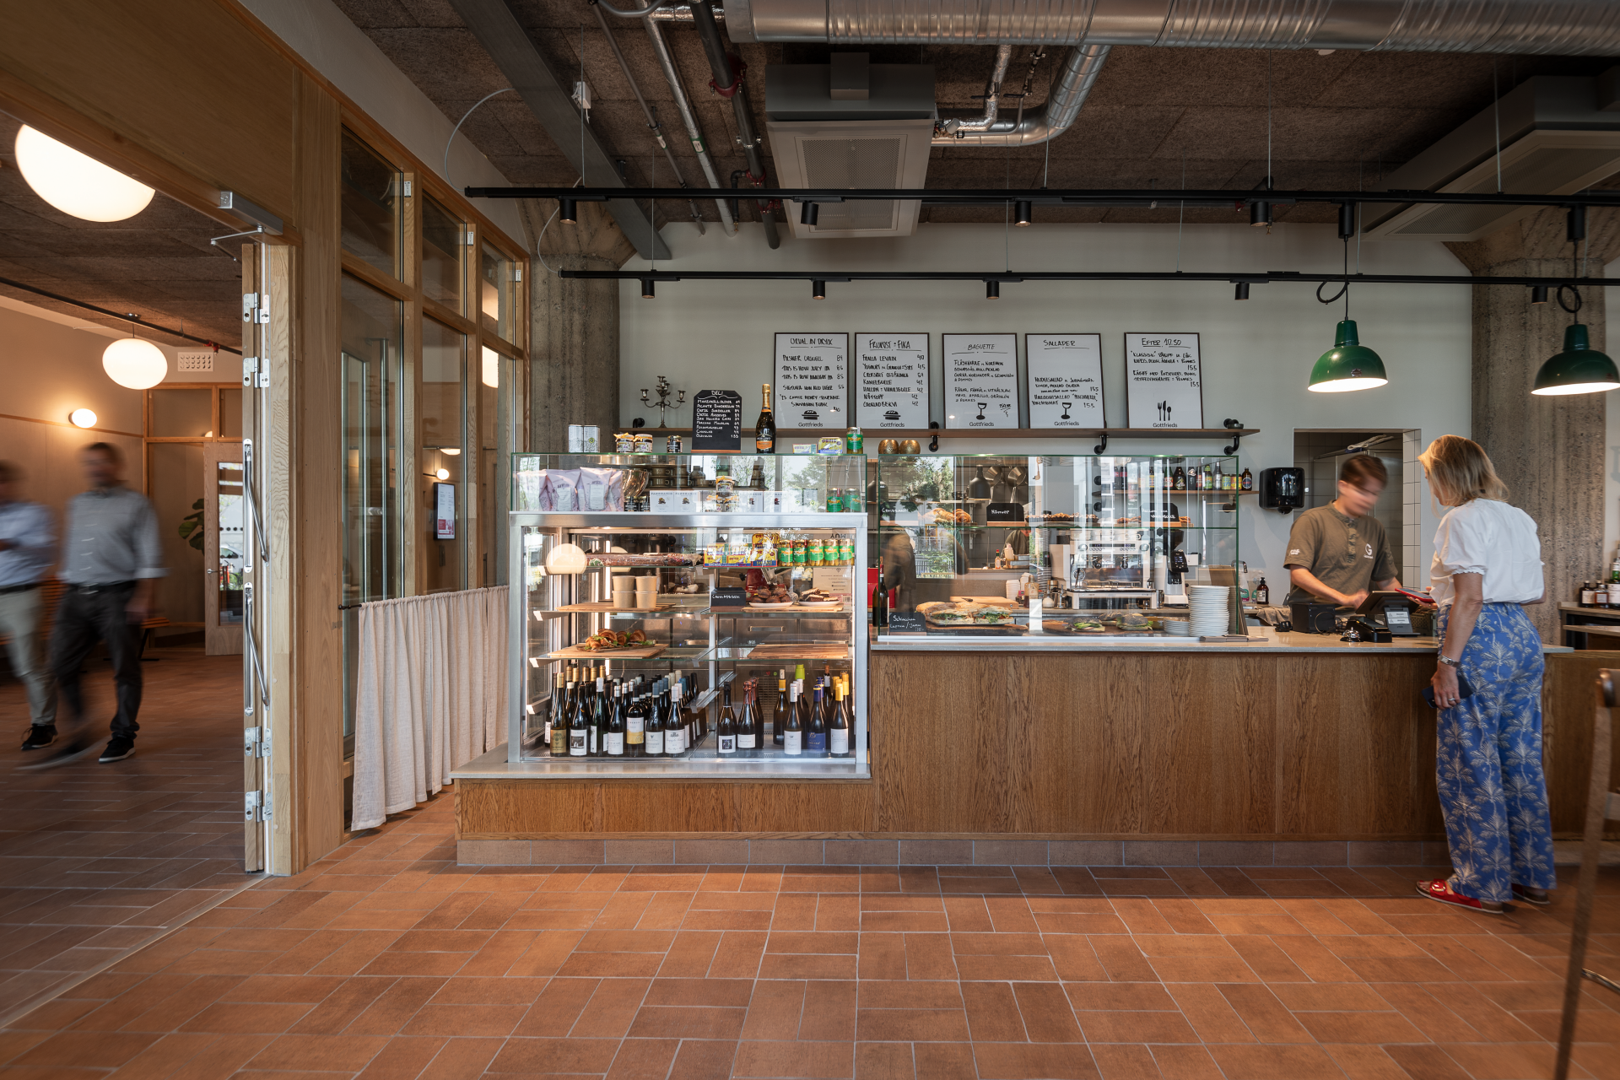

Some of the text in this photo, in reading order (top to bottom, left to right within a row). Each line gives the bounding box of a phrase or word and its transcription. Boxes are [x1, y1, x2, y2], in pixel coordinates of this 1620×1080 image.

[869, 339, 891, 349] FRUKOST
[898, 340, 910, 349] FIKA
[1365, 543, 1372, 556] G
